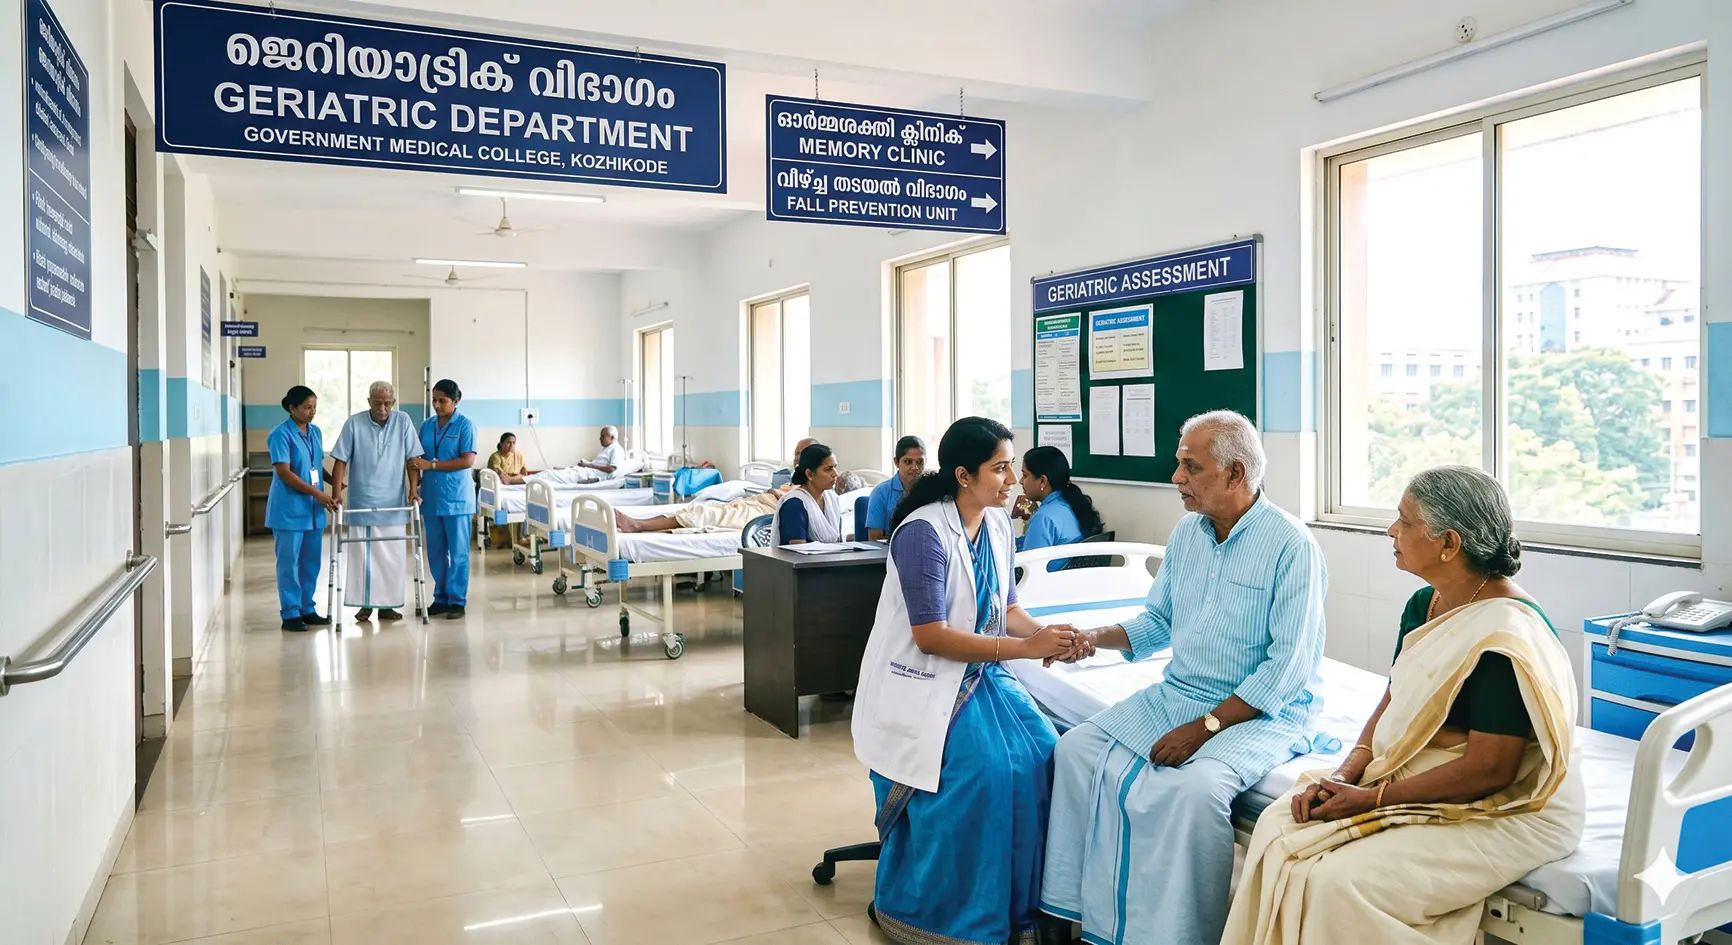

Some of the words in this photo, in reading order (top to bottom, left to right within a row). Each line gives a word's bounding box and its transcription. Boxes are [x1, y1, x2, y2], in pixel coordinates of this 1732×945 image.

[227, 32, 521, 93] ജെറിയാട്രിക്
[529, 59, 675, 110] വിഭാഗം
[214, 81, 437, 130] GERIATRIC
[451, 104, 693, 153] DEPARTMENT
[901, 120, 967, 147] ക്ലിനിക്
[244, 126, 384, 152] GOVERNMENT
[390, 139, 473, 159] MEDICAL
[478, 146, 566, 169] COLLEGE,
[571, 153, 668, 175] KOZHIKODE
[799, 137, 883, 160] MEMORY
[887, 146, 946, 166] CLINIC
[834, 176, 901, 196] തടയൽ
[906, 178, 967, 201] വിഭാഗം
[787, 196, 825, 212] FALL
[829, 199, 922, 219] PREVENTION
[925, 205, 958, 221] UNIT
[1047, 277, 1118, 303] GERIATRIC
[1121, 256, 1231, 292] ASSESSMENT
